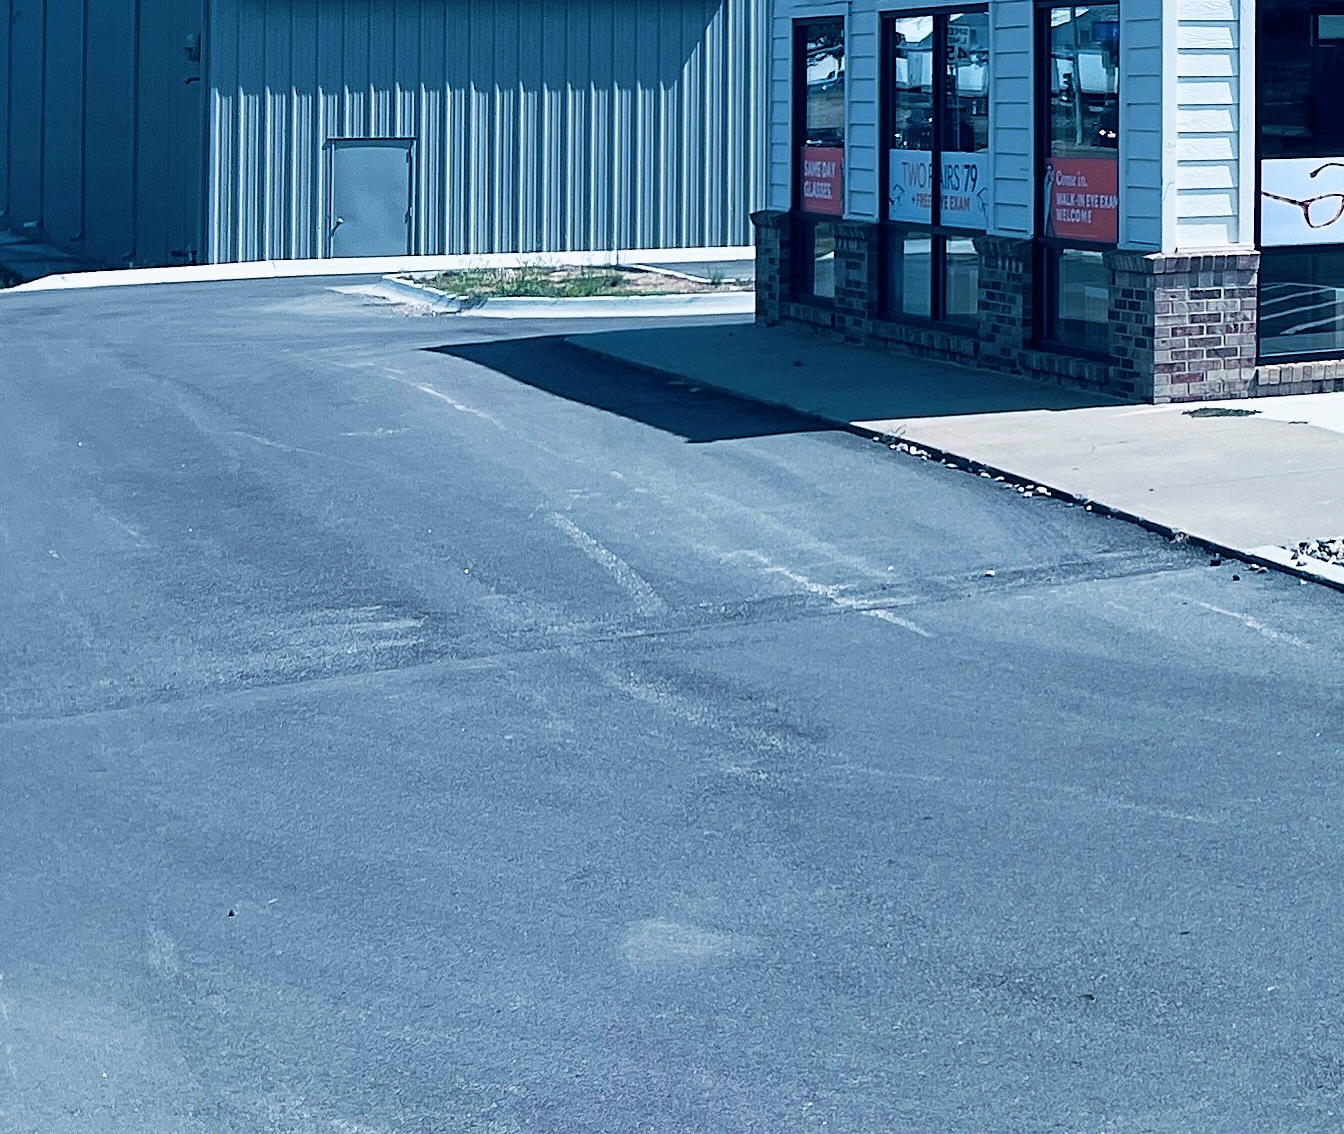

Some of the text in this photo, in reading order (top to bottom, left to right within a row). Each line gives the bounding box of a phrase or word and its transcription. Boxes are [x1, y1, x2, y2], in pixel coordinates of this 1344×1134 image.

[902, 161, 926, 189] TWO
[928, 162, 960, 192] PIRS
[1056, 193, 1085, 207] WALK-IN
[1086, 194, 1099, 208] EYE
[1056, 208, 1092, 224] WELCOME
